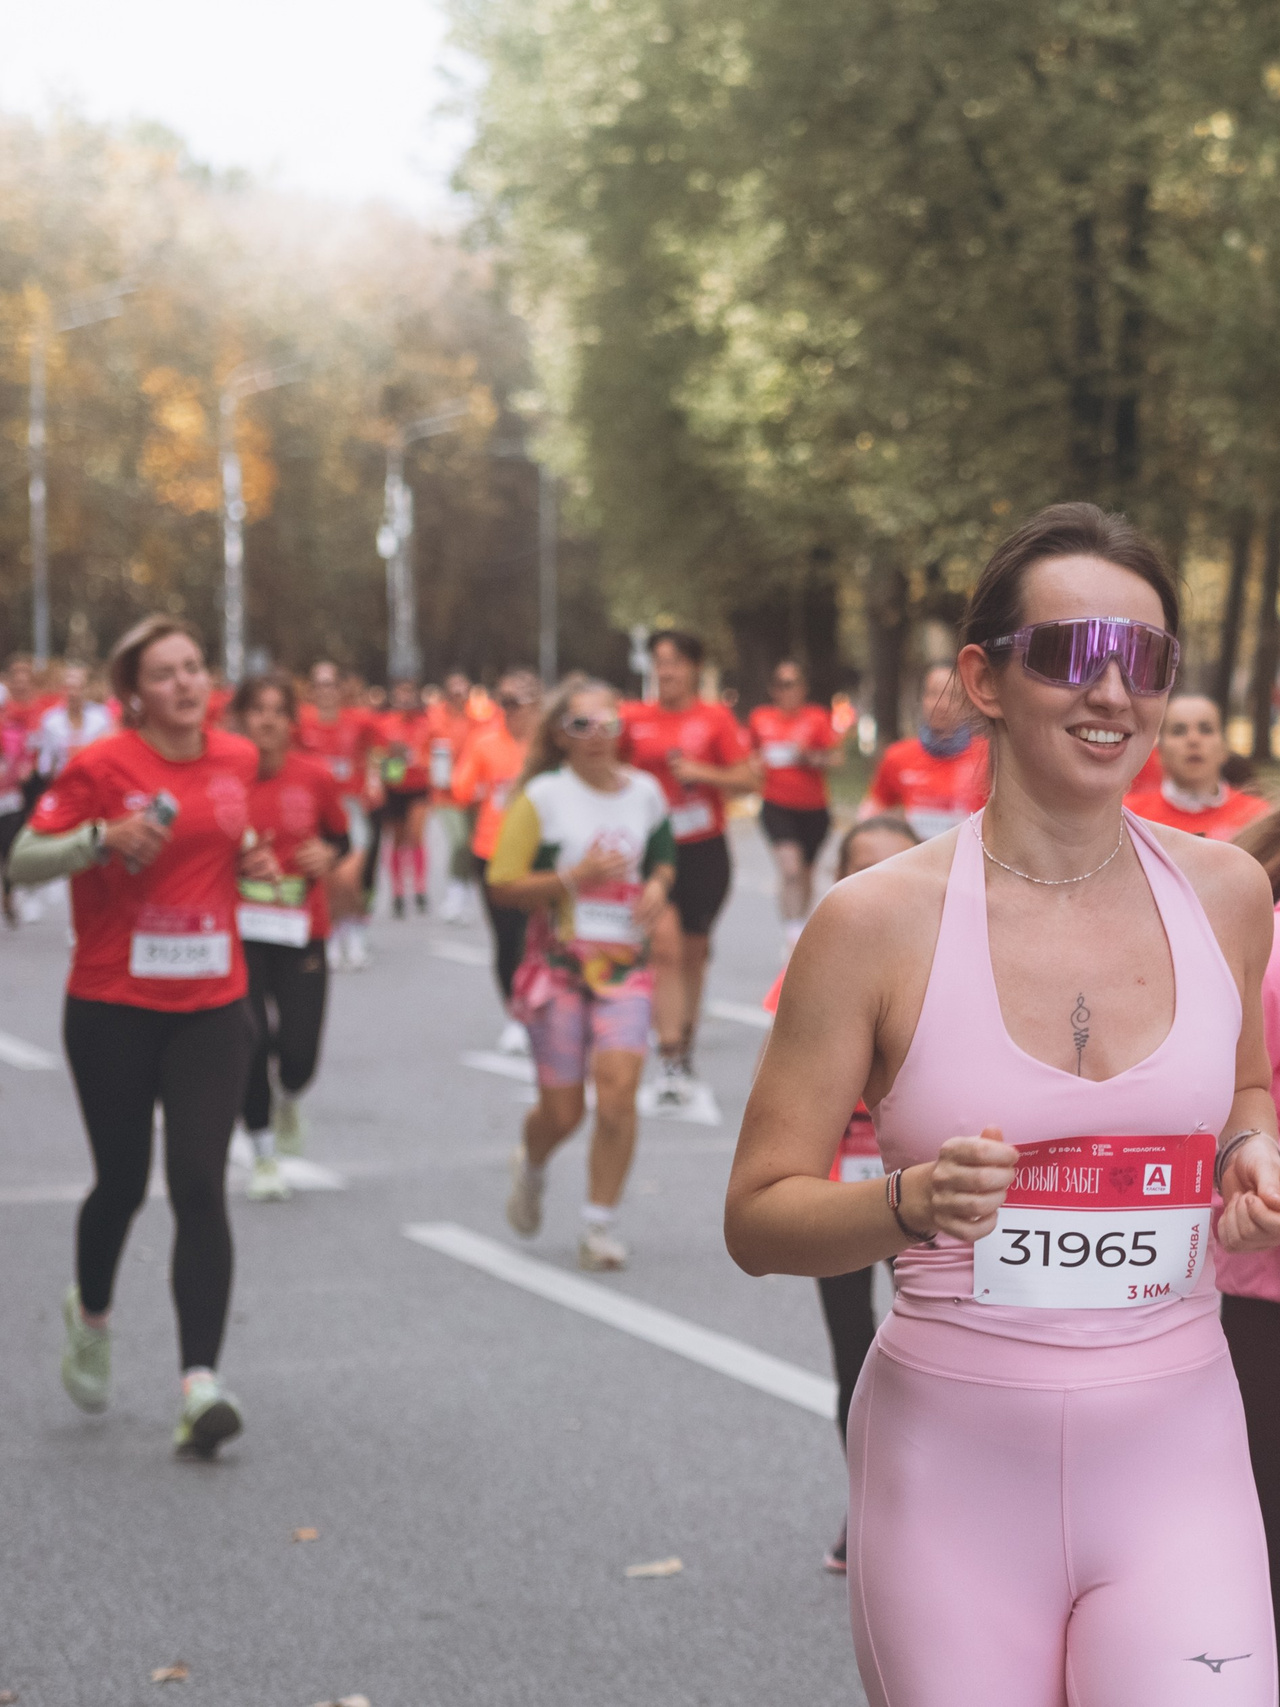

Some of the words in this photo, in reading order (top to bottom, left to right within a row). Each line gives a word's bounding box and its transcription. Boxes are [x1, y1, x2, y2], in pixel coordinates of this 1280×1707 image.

[1006, 1162, 1059, 1192] ЗОВЫЙ
[1061, 1165, 1104, 1194] ЗАБЕГ
[998, 1228, 1157, 1268] 31965
[1185, 1223, 1200, 1279] МОСКВА
[1127, 1284, 1138, 1300] 3
